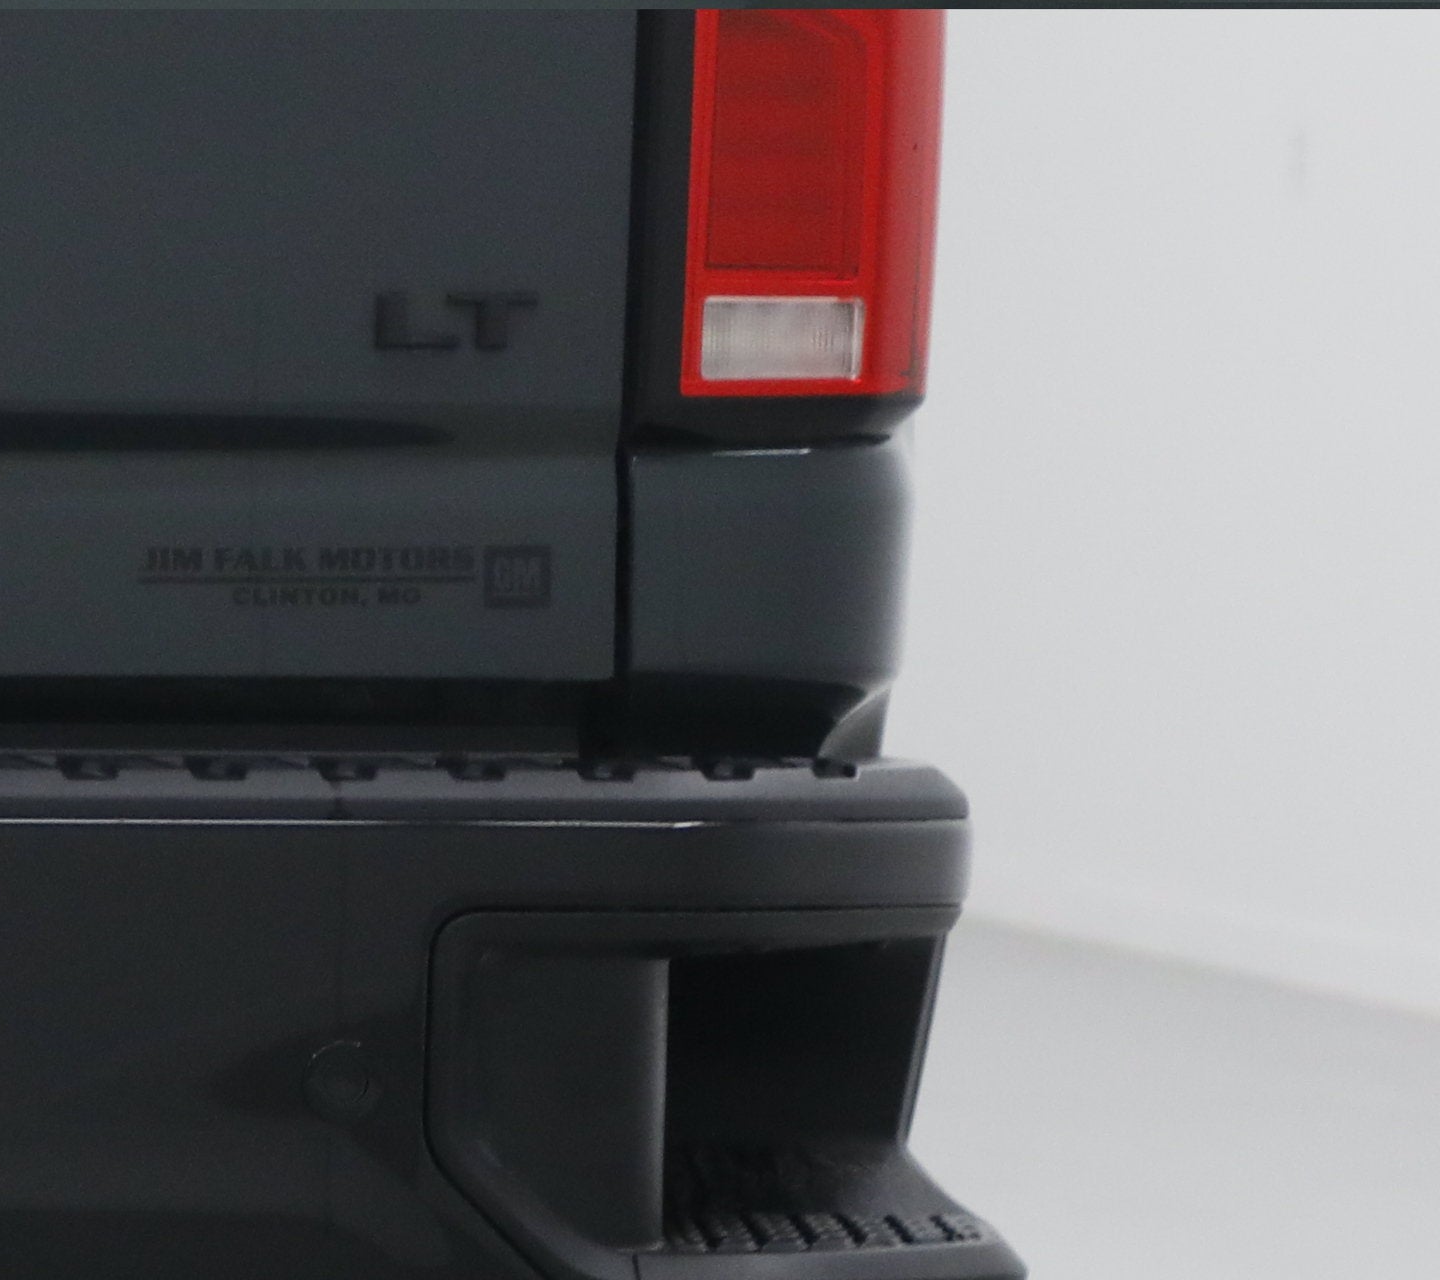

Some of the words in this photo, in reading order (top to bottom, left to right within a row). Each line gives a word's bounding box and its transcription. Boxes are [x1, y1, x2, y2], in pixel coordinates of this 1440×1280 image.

[373, 290, 538, 351] LT
[145, 545, 203, 571] JIM
[215, 545, 306, 571] FALK
[317, 545, 474, 571] MOTORS
